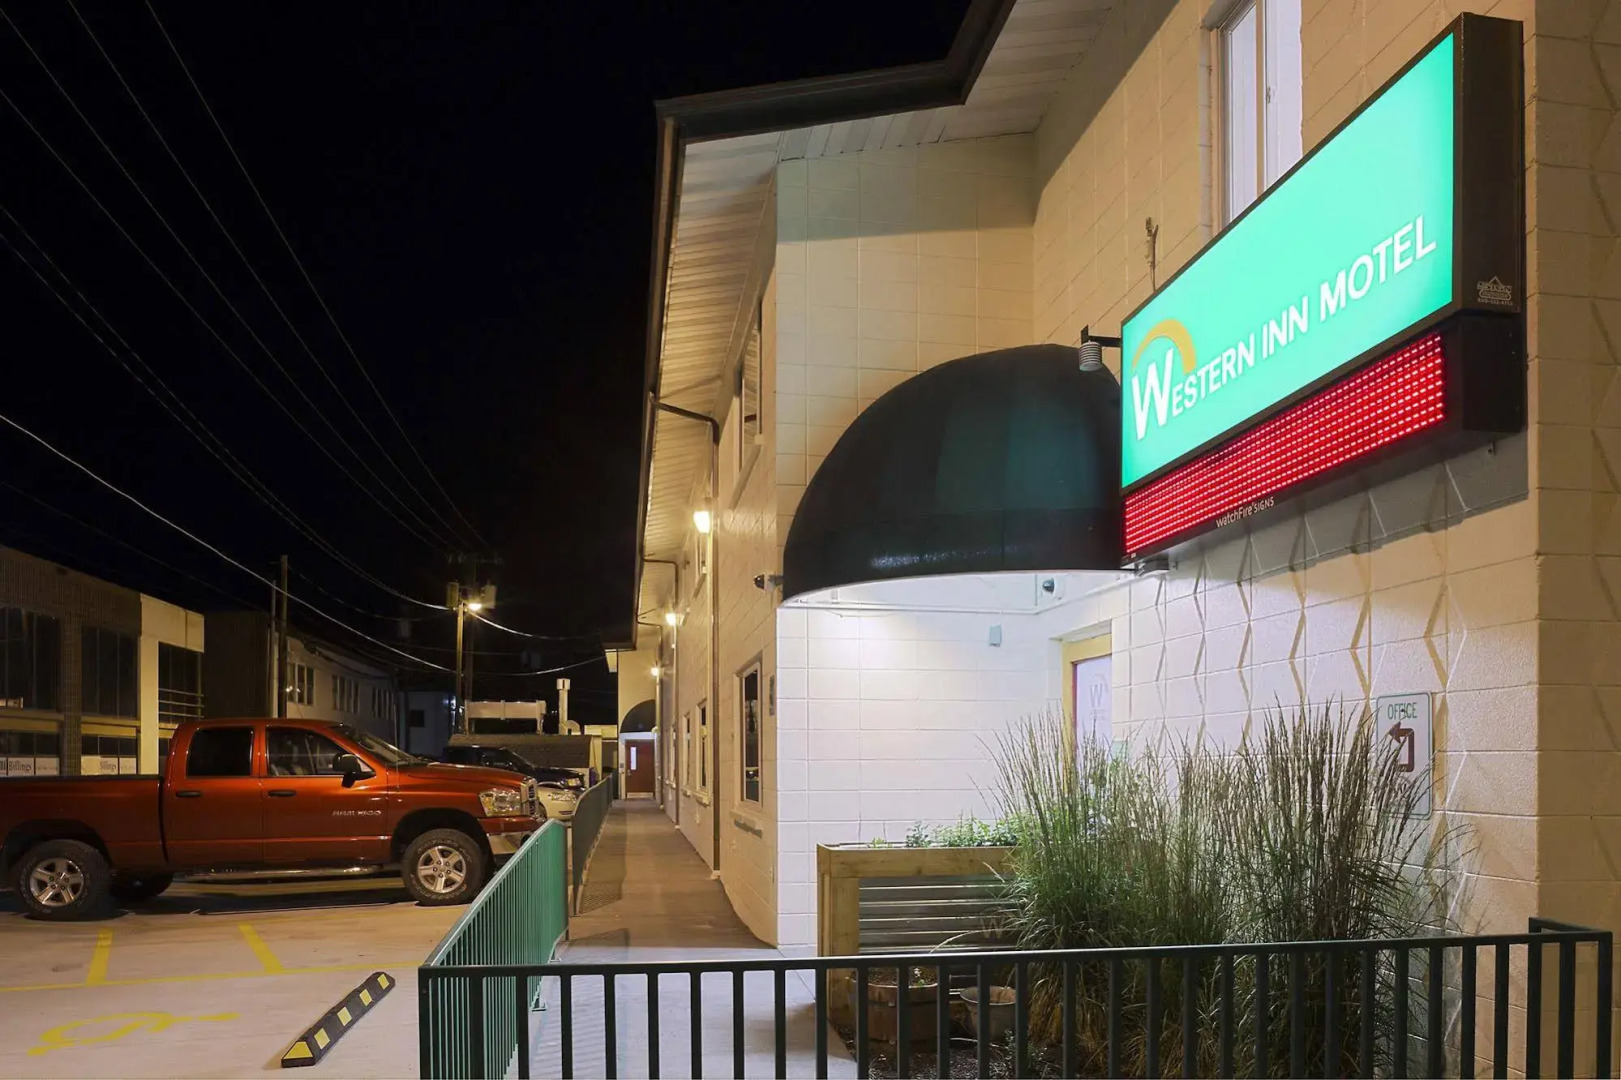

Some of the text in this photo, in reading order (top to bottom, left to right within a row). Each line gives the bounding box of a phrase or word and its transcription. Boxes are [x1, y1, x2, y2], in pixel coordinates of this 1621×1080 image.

[1131, 214, 1437, 441] WESTERN INN MOTEL
[1387, 702, 1418, 720] OFFICE
